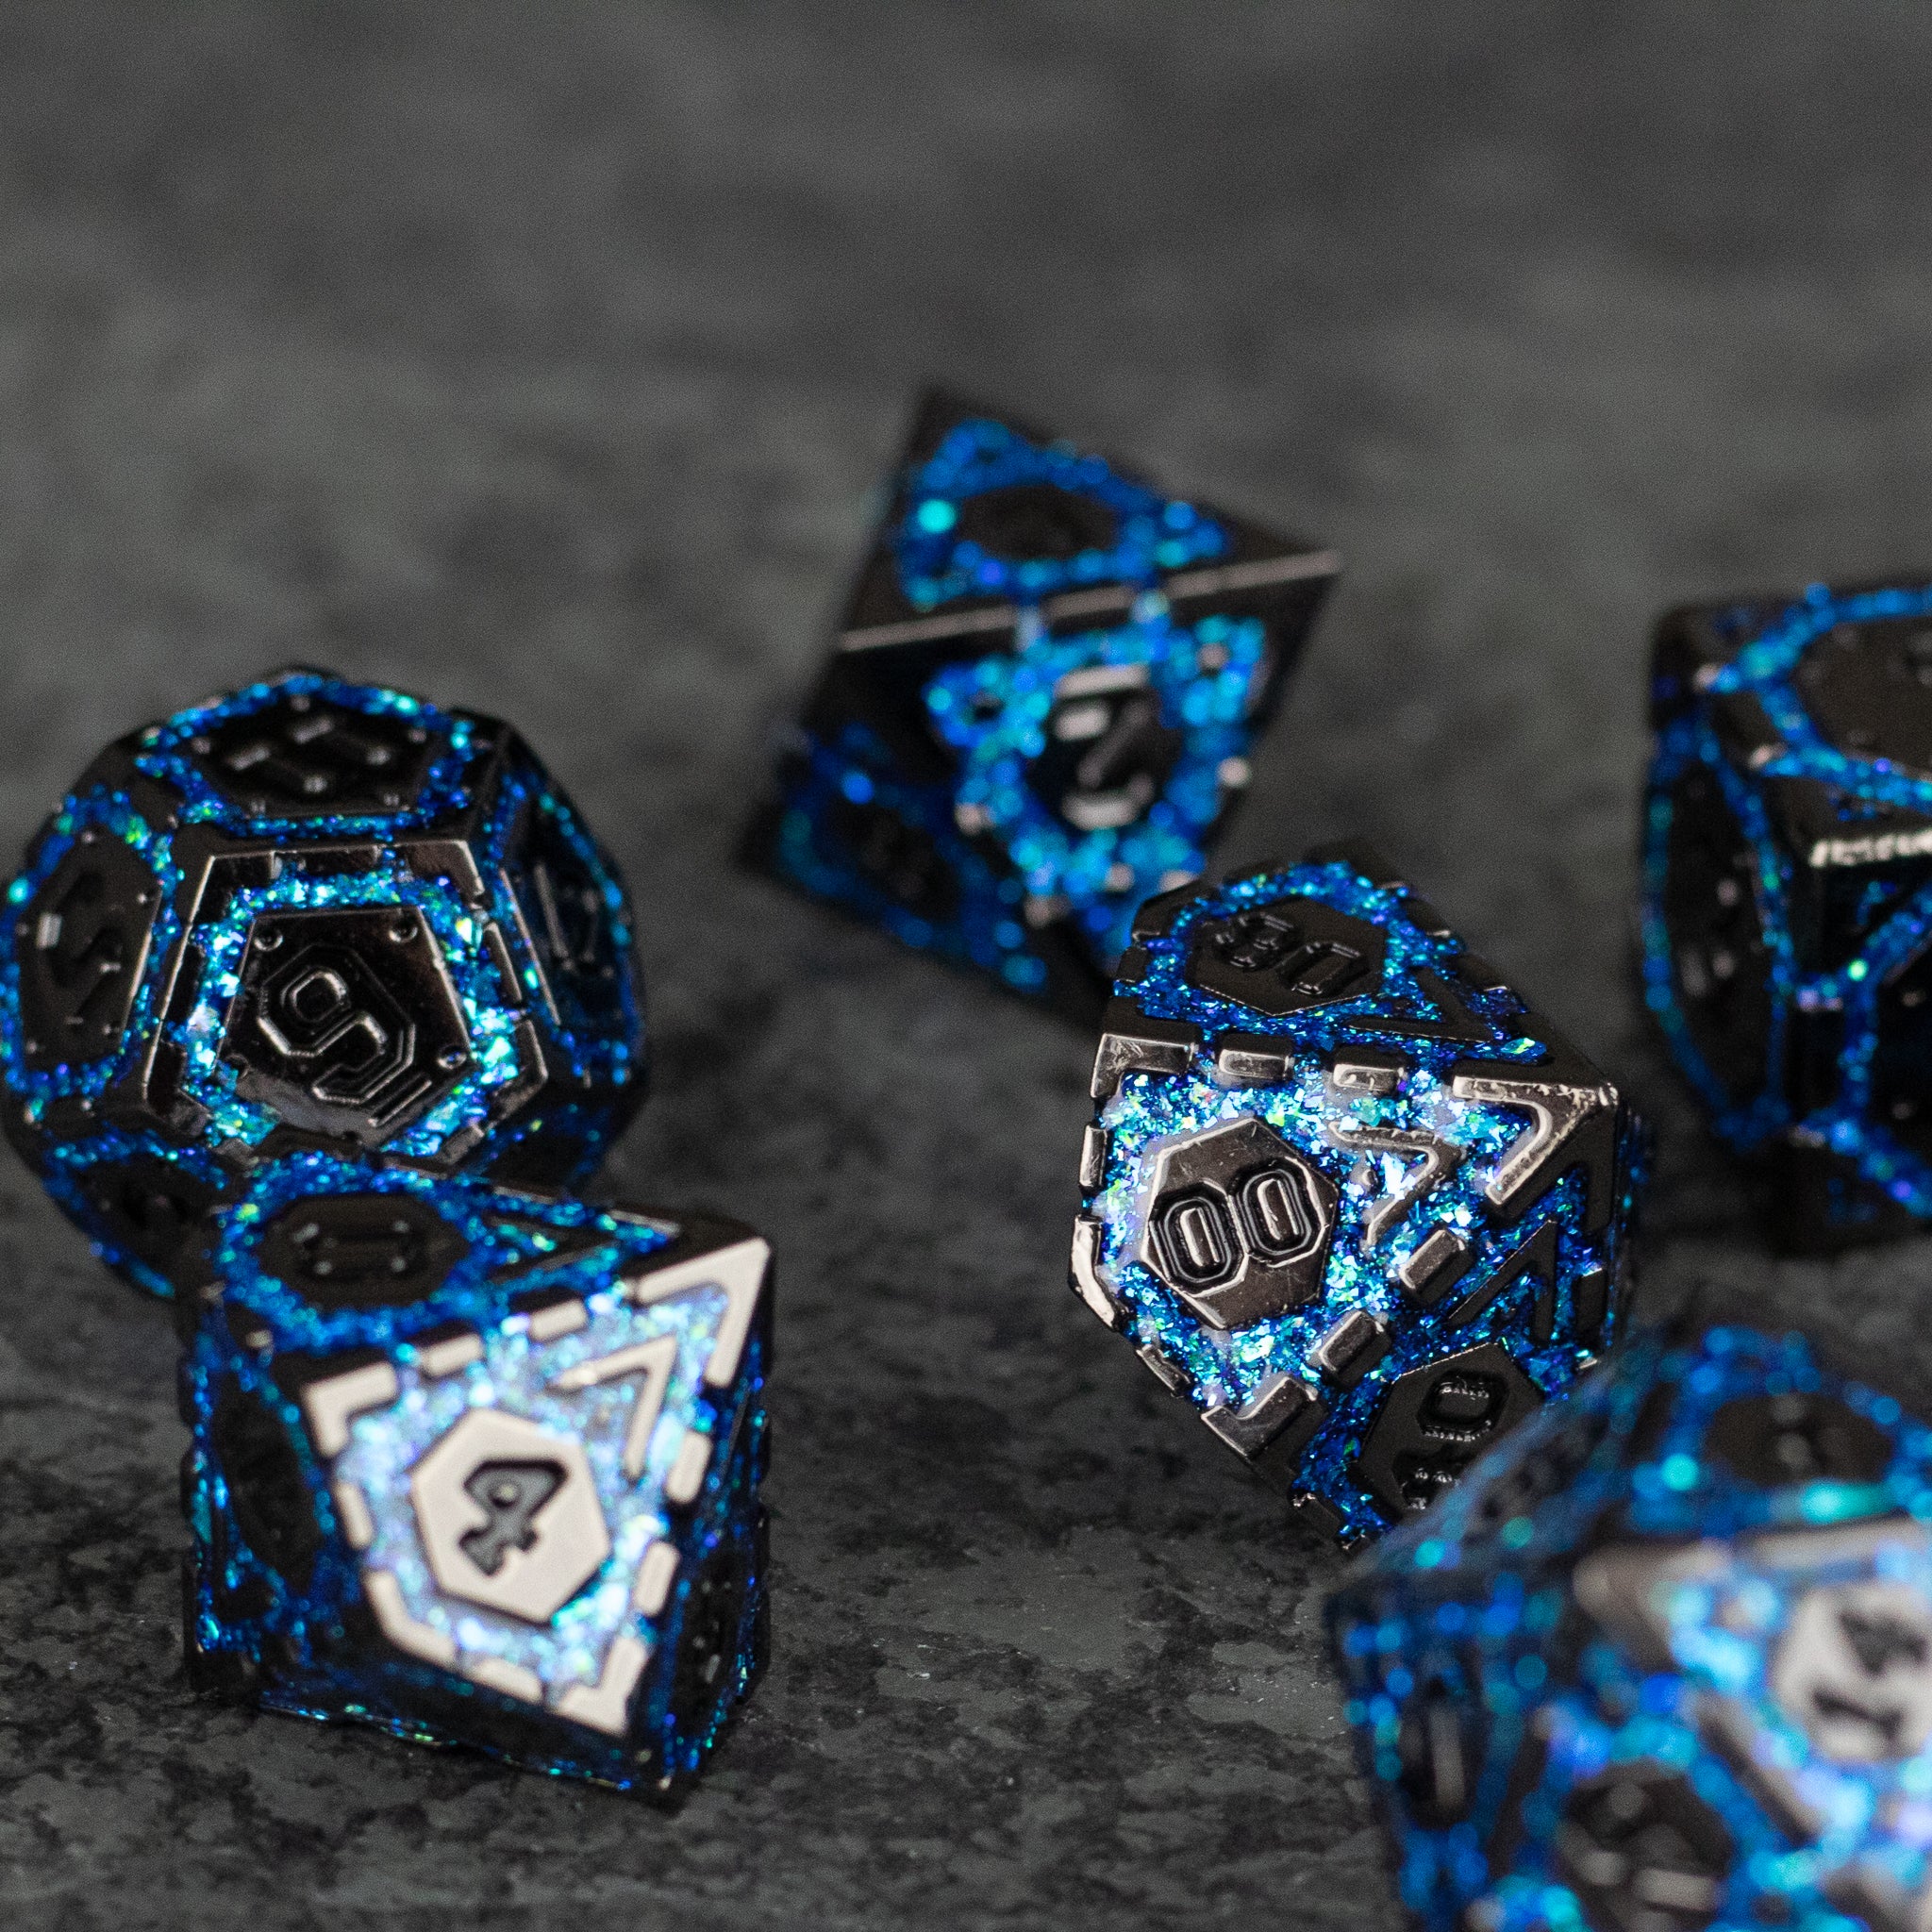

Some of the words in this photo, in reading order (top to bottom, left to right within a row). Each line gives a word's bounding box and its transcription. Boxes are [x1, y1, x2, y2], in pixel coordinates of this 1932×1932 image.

[257, 943, 418, 1109] 9
[1147, 1157, 1331, 1297] 00
[456, 1457, 569, 1576] 4
